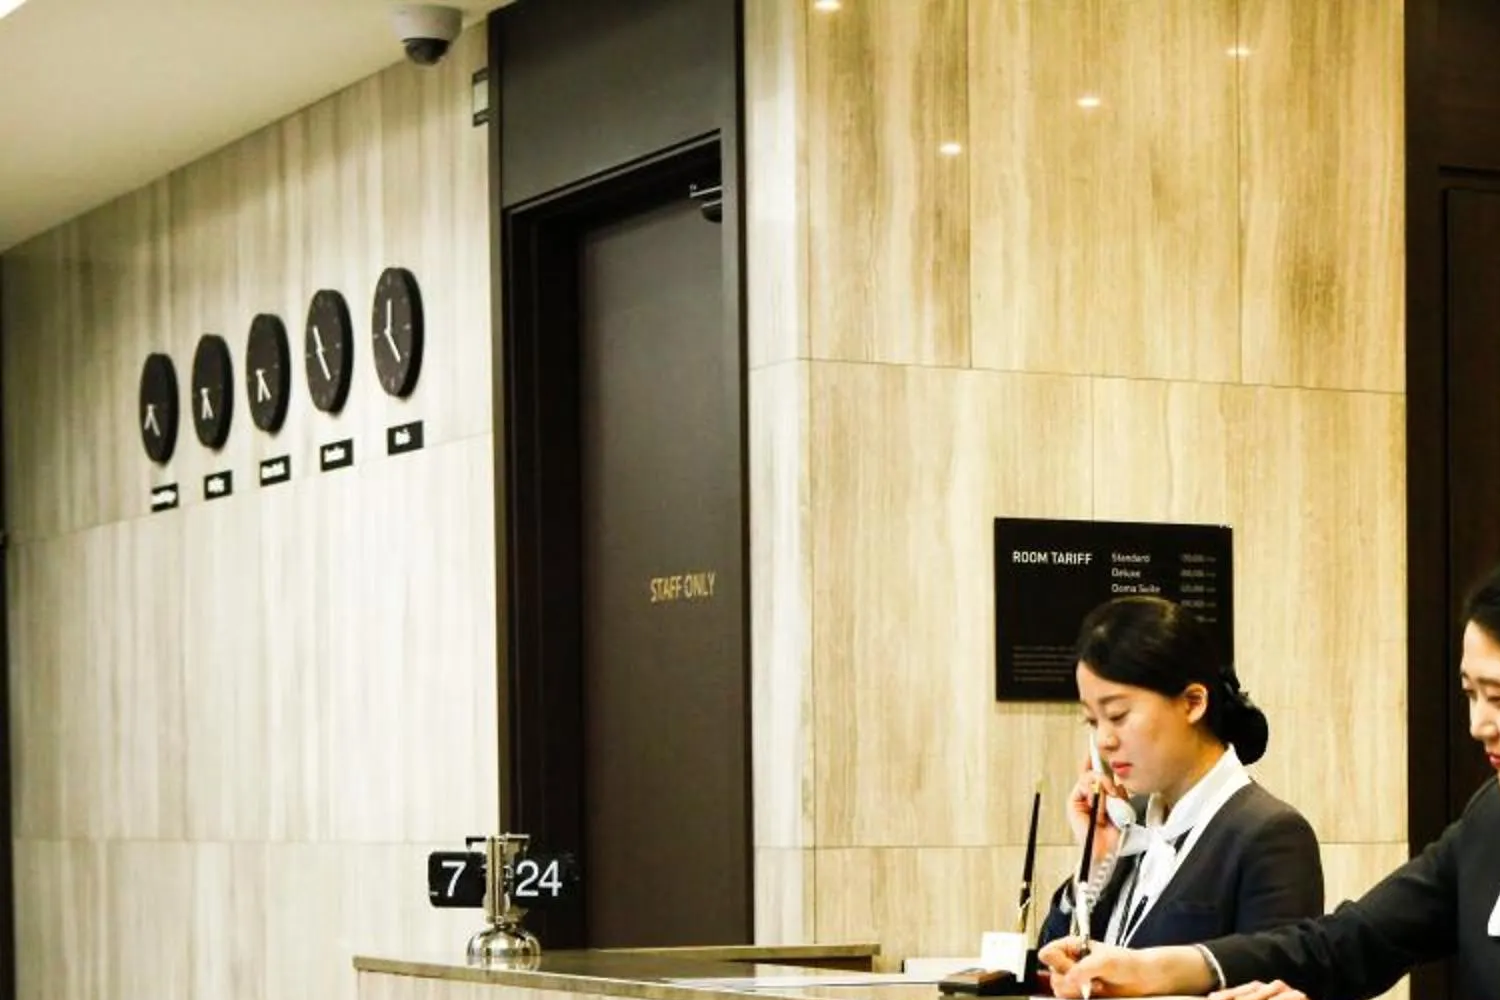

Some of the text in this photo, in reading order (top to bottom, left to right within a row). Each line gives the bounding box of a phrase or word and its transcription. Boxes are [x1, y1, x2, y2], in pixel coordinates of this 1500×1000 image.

[1012, 550, 1093, 565] ROOM TARIFF
[650, 570, 717, 603] STAFF ONLY
[441, 860, 563, 897] 7 24
